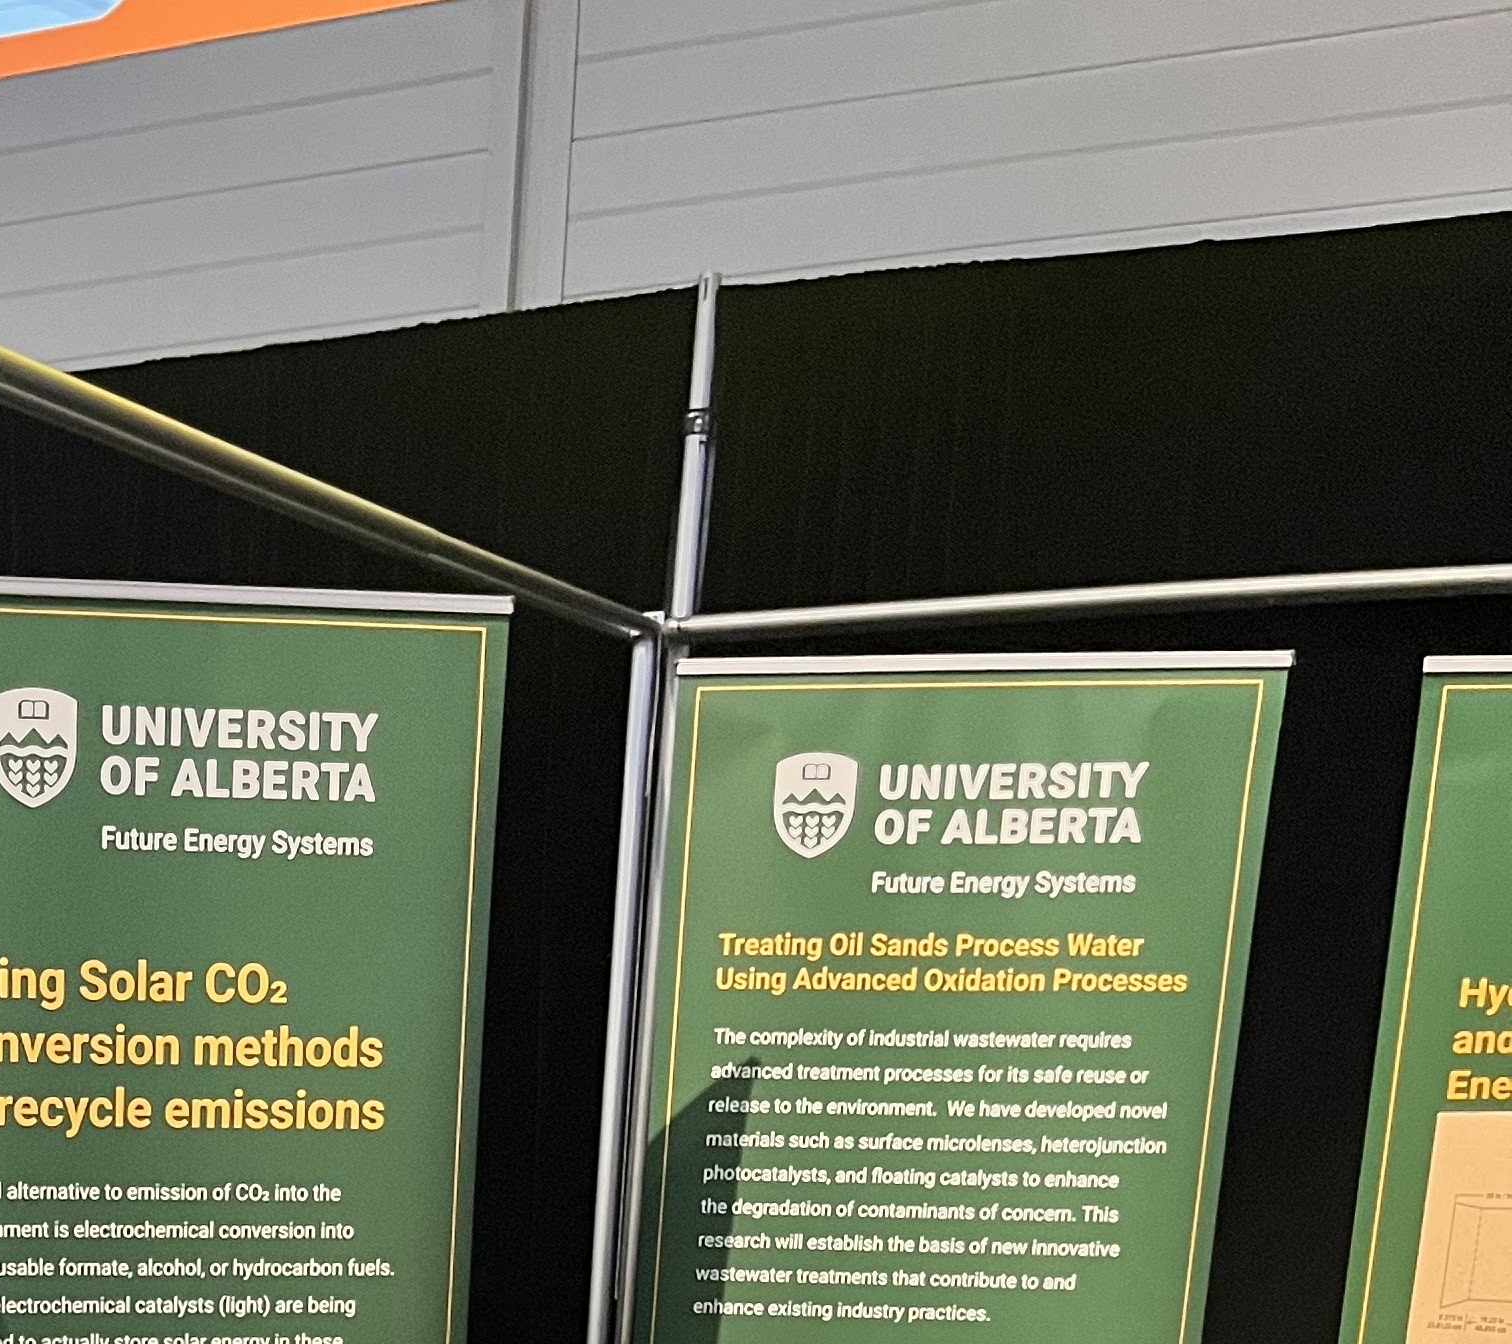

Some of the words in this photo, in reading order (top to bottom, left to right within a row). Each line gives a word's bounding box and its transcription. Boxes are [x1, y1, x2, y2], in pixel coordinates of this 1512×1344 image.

[101, 704, 379, 752] UNIVERSITY
[100, 755, 160, 795] OF
[170, 758, 375, 802] ALBERTA
[879, 760, 1150, 800] UNIVERSITY
[874, 808, 933, 844] OF
[940, 806, 1141, 845] ALBERTA
[101, 825, 177, 851] Future
[183, 827, 266, 859] Energy
[271, 829, 373, 860] Systems
[871, 870, 945, 893] Future
[949, 870, 1030, 898] Energy
[1033, 870, 1136, 898] Systems
[718, 931, 823, 961] Treating
[829, 931, 864, 956] Oil
[869, 931, 949, 957] Sands
[955, 932, 1060, 957] Process
[1067, 932, 1145, 956] Water
[79, 958, 193, 1002] Solar
[715, 966, 787, 995] Using
[791, 965, 918, 991] Advanced
[923, 966, 1046, 992] Oxidation
[1052, 967, 1188, 992] Processes
[193, 1025, 383, 1068] methods
[713, 1027, 746, 1044] The
[749, 1027, 843, 1050] complexity
[846, 1028, 866, 1046] of
[868, 1028, 949, 1047] industrial
[953, 1031, 1056, 1048] wastewater
[1058, 1030, 1132, 1052] requires
[1447, 1070, 1512, 1100] Ene
[164, 1088, 384, 1130] emissions
[708, 1095, 770, 1113] release
[773, 1097, 791, 1114] to
[795, 1096, 823, 1114] the
[826, 1098, 937, 1117] environment.
[947, 1099, 975, 1117] We
[978, 1099, 1021, 1117] have
[1024, 1100, 1116, 1122] developed
[1119, 1101, 1168, 1119] novel
[6, 1180, 100, 1200] alternative
[103, 1183, 123, 1200] to
[126, 1182, 207, 1201] emission
[212, 1182, 232, 1201] of
[274, 1183, 308, 1201] into
[312, 1183, 341, 1202] the
[54, 1219, 69, 1238] is
[73, 1219, 214, 1238] electrochemical
[218, 1221, 315, 1239] conversion
[320, 1221, 354, 1239] into
[58, 1257, 133, 1278] formate,
[137, 1257, 205, 1278] alcohol,
[209, 1262, 229, 1276] or
[232, 1257, 343, 1280] hydrocarbon
[347, 1257, 395, 1276] fuels.
[134, 1295, 214, 1318] catalysts
[218, 1294, 270, 1317] (light)
[274, 1299, 303, 1313] are
[307, 1295, 356, 1317] being
[692, 1298, 764, 1315] enhance
[767, 1300, 833, 1321] existing
[836, 1301, 905, 1323] industry
[907, 1304, 991, 1323] practices.
